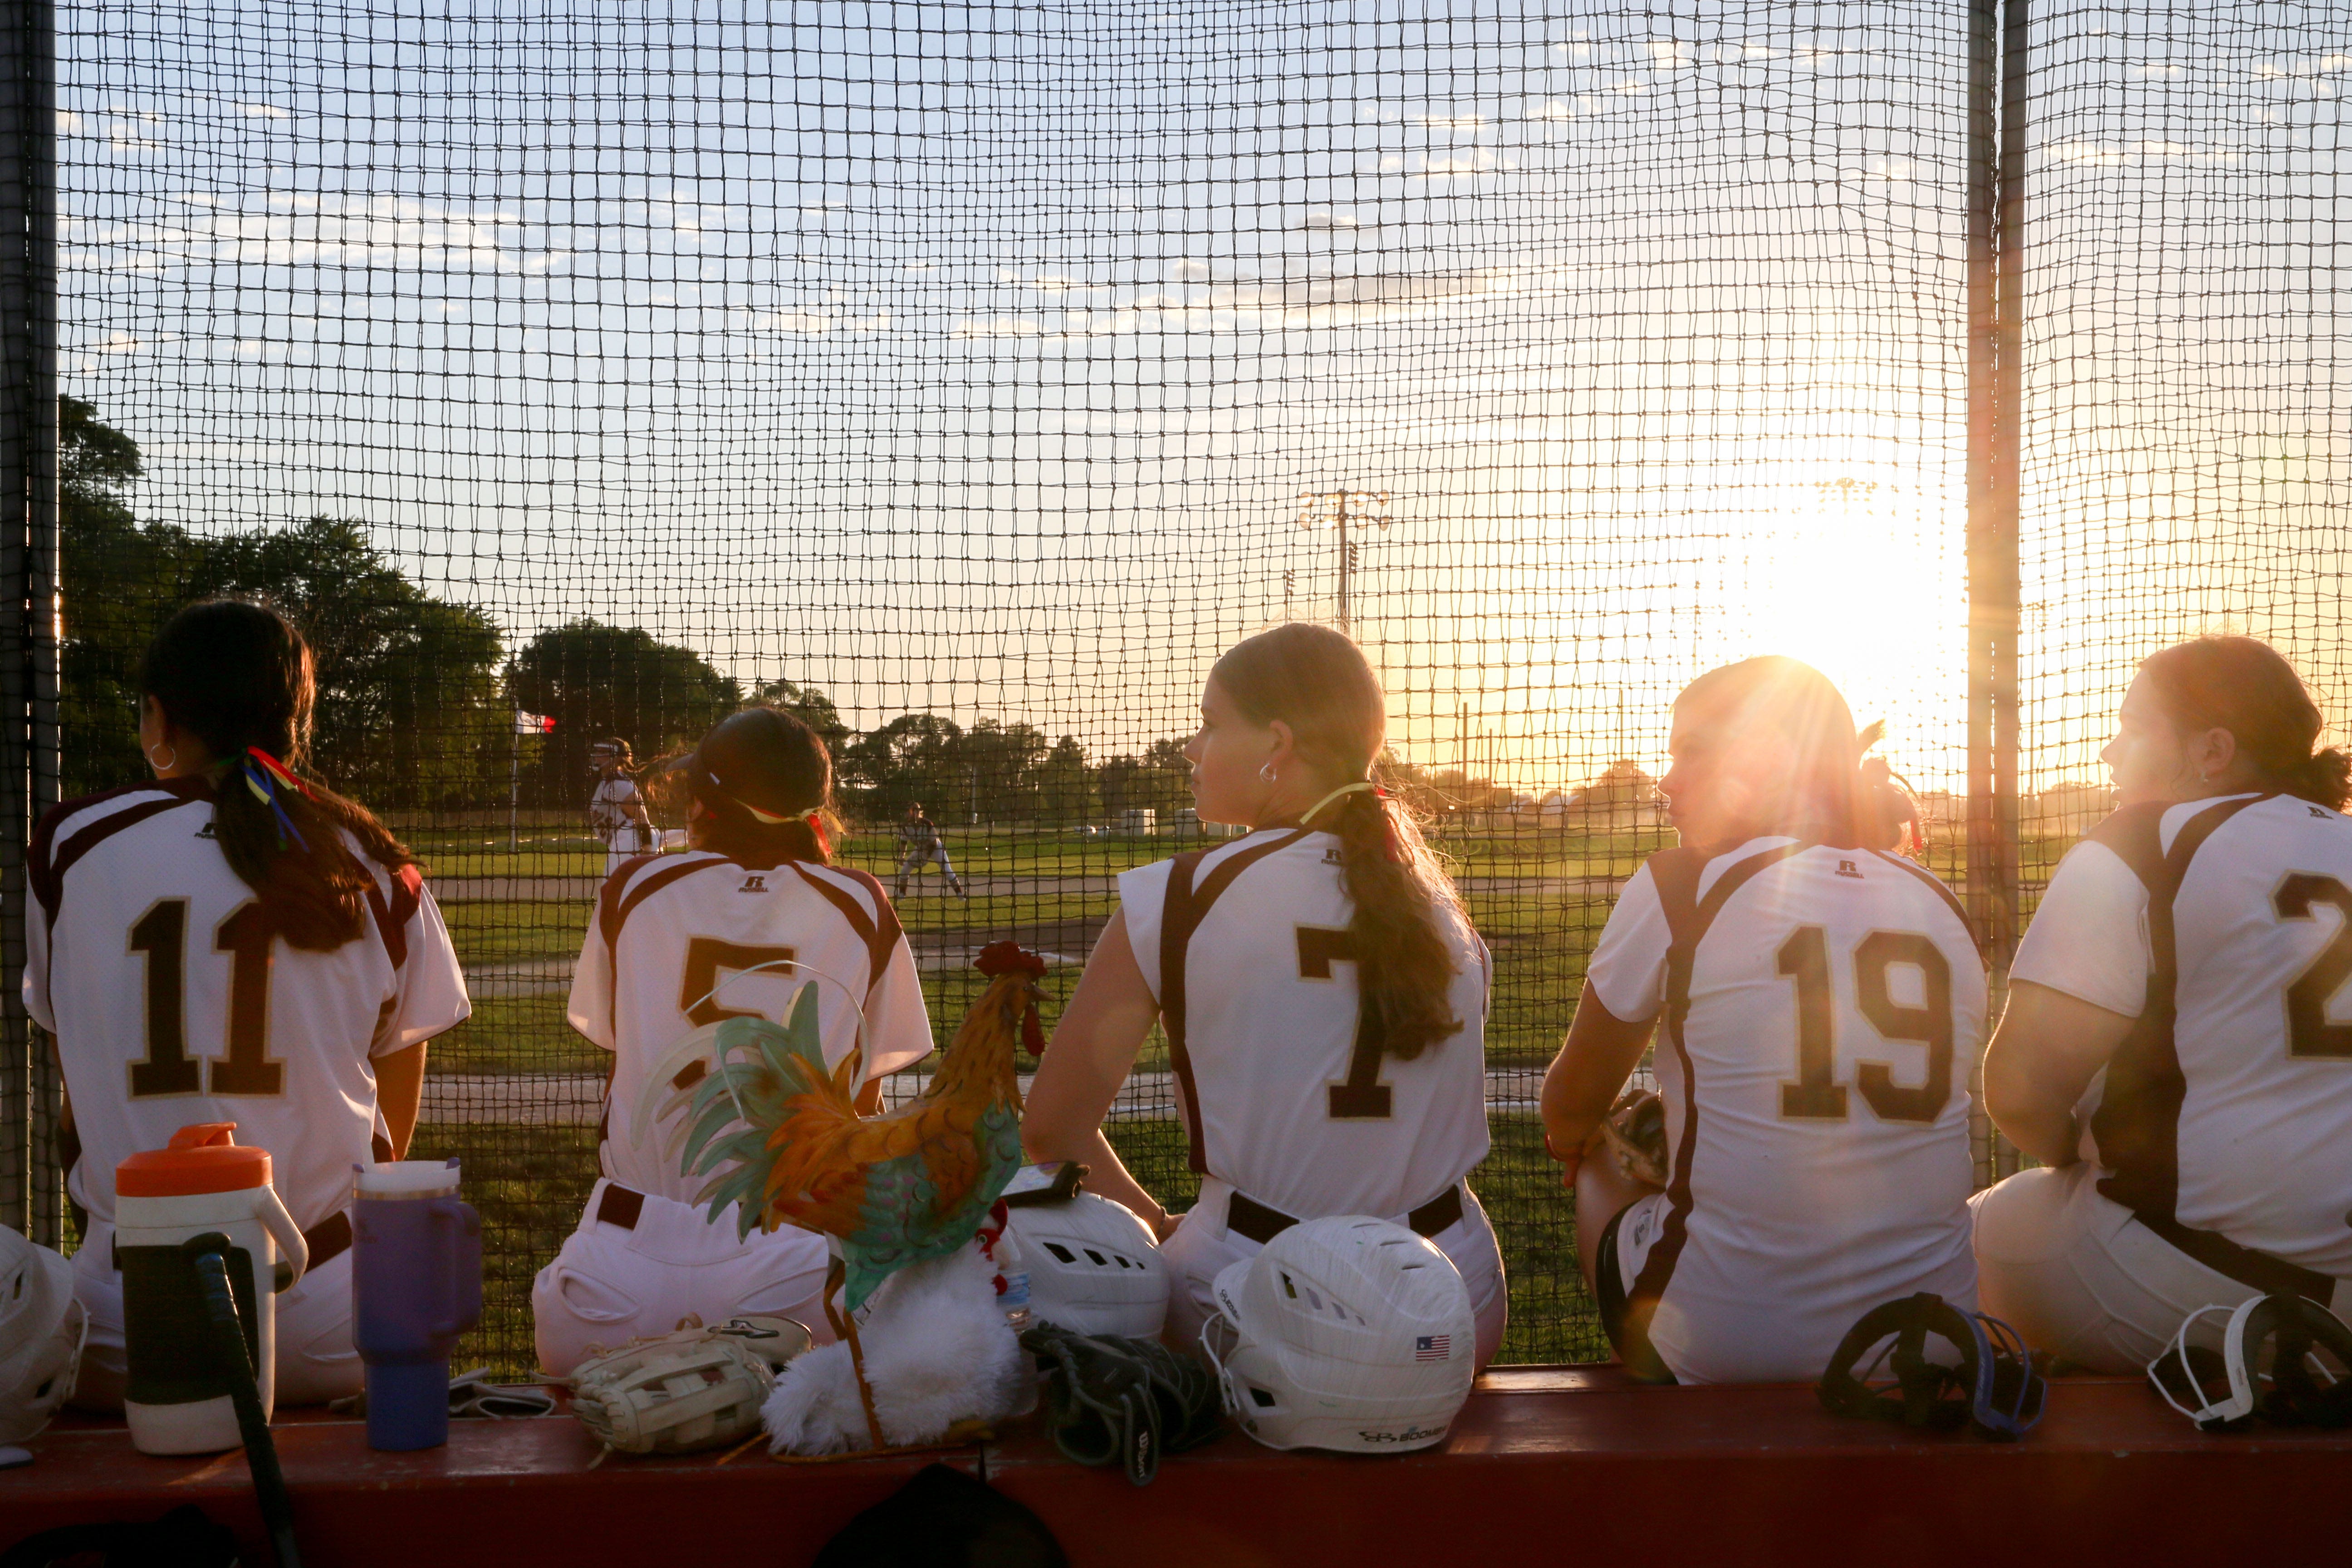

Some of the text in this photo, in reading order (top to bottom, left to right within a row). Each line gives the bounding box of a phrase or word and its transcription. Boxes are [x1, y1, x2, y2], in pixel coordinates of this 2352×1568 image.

[745, 876, 765, 887] R
[1840, 860, 1856, 872] R
[126, 895, 287, 1101] 11
[1294, 921, 1394, 1122] 7
[1774, 923, 1954, 1127] 19
[2268, 869, 2352, 1062] 2
